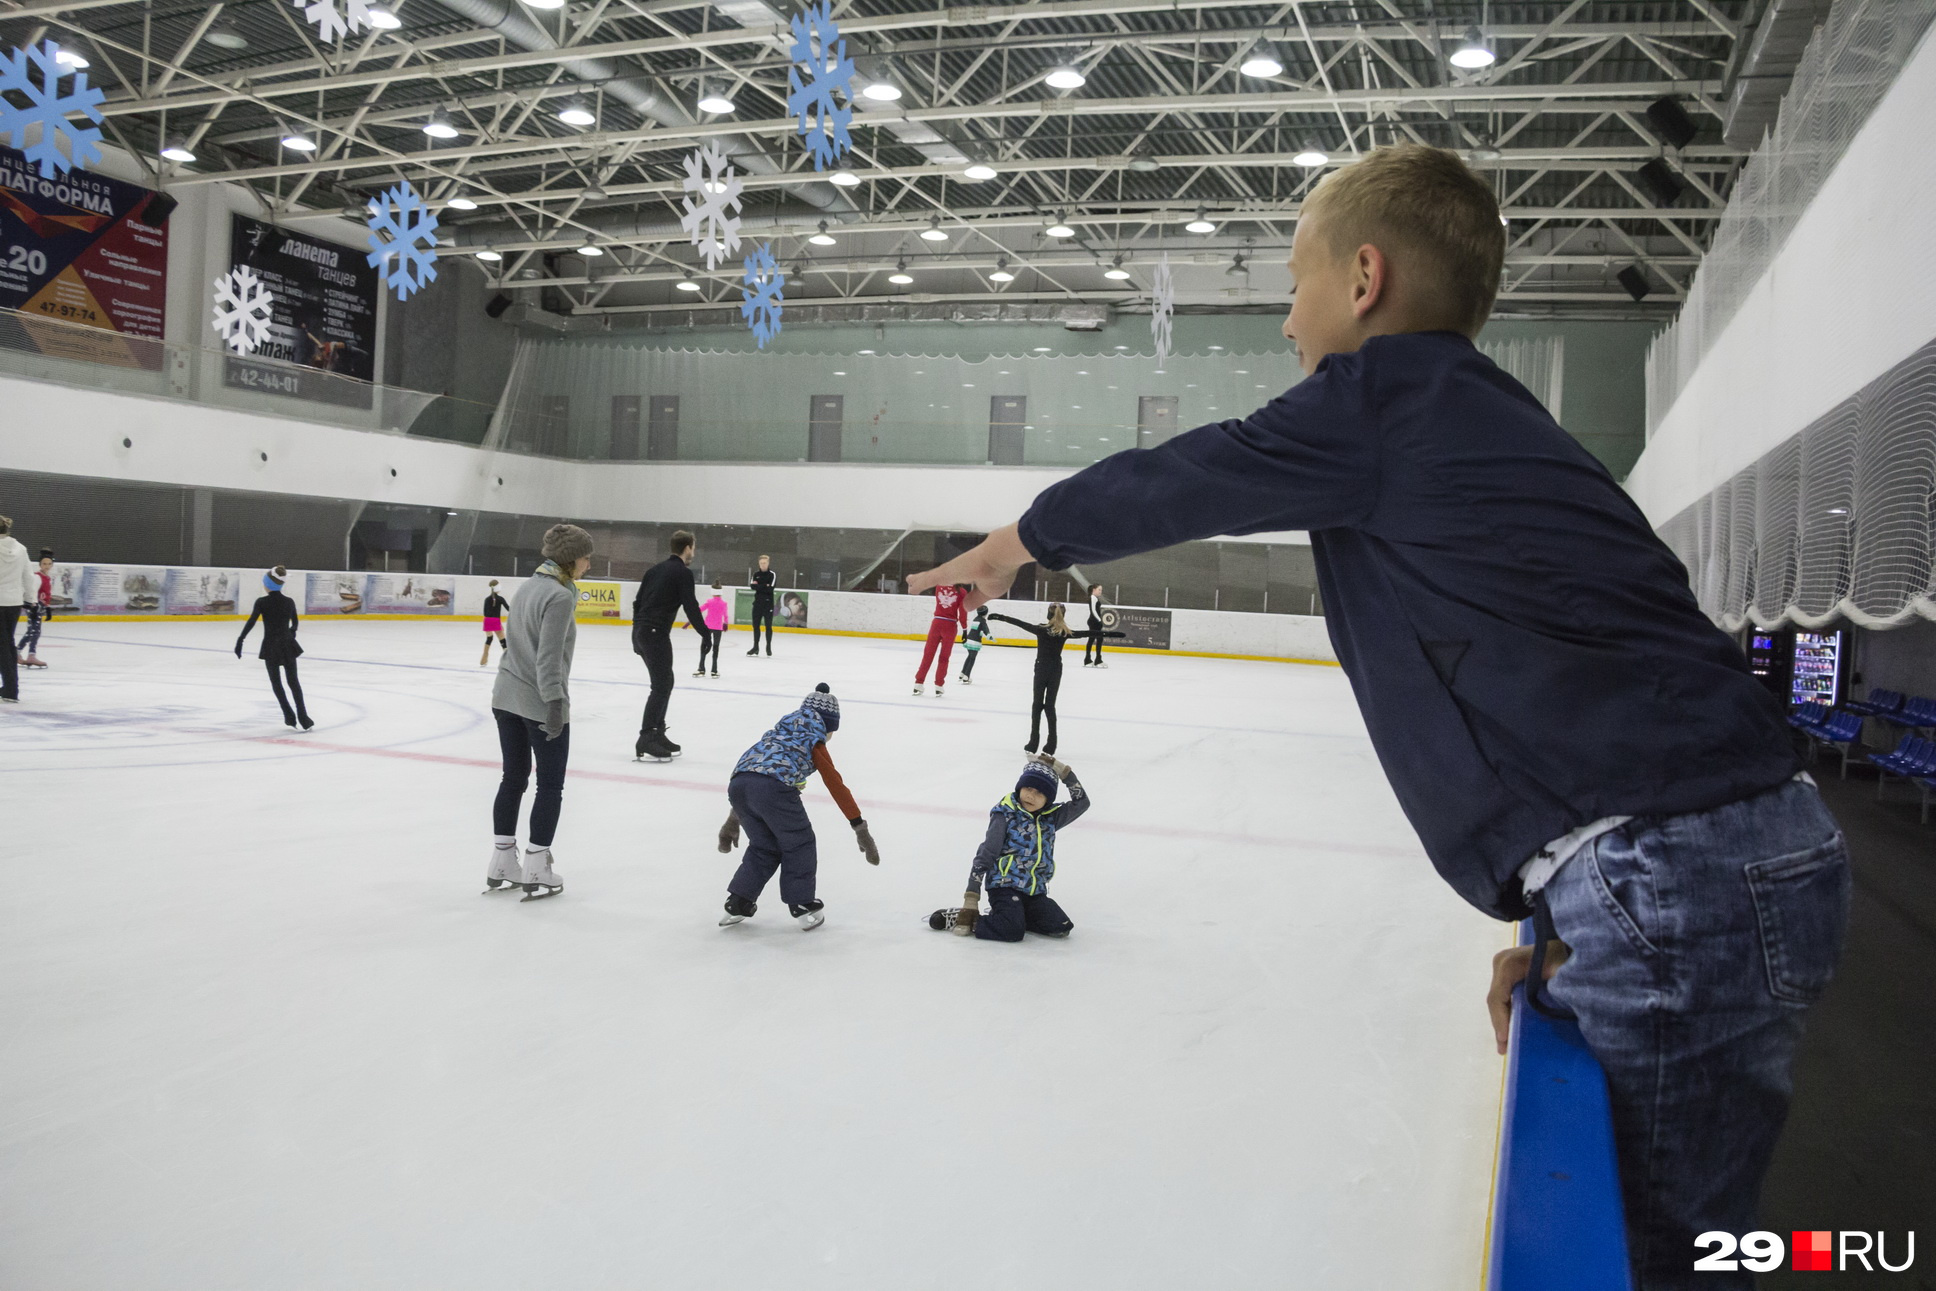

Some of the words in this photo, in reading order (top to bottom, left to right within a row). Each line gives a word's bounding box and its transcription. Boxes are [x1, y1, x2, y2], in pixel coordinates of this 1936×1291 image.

[317, 265, 357, 287] танцев
[40, 301, 97, 321] 47-97-74
[240, 369, 299, 393] 42-44-01
